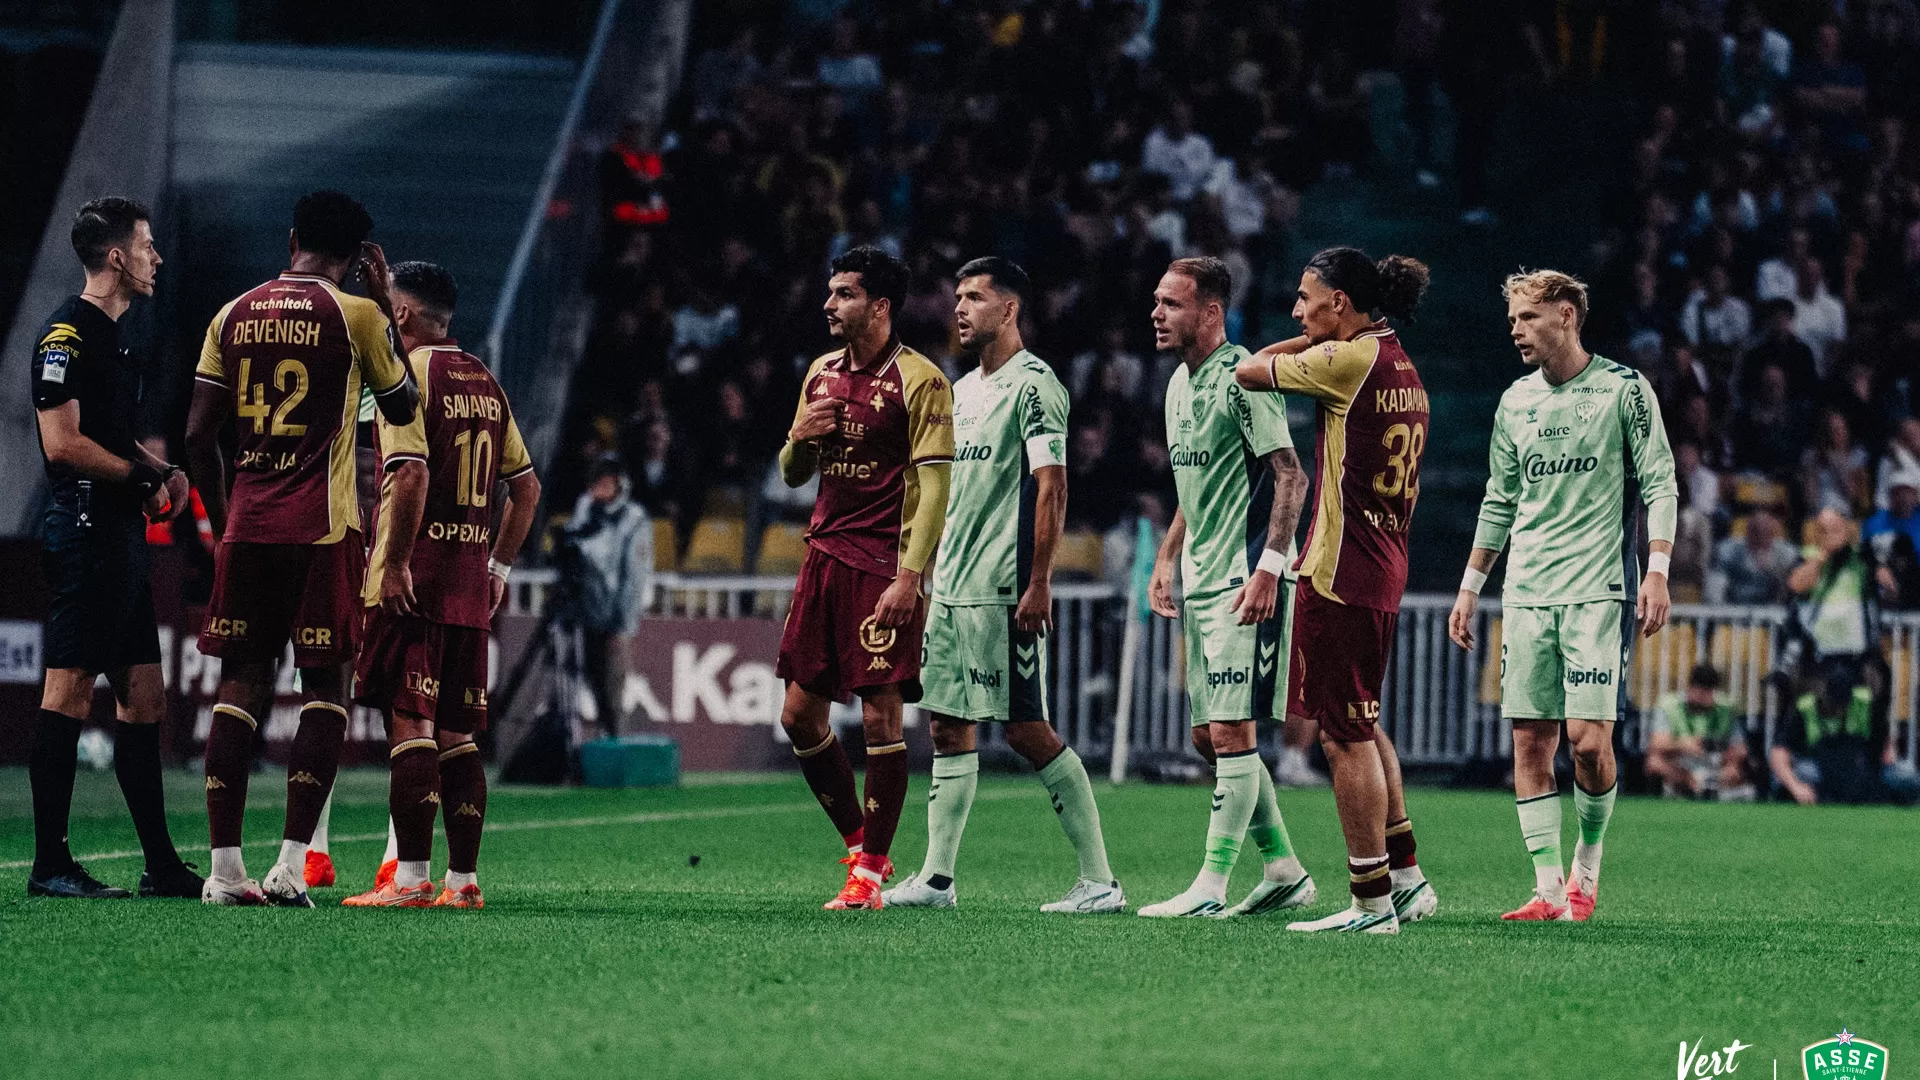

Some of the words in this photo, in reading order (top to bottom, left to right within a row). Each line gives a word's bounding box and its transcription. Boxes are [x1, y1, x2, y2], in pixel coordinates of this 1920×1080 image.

[233, 319, 321, 346] DEVENISH
[50, 343, 80, 358] POSTE
[237, 357, 309, 437] 42
[454, 429, 493, 508] 10
[1372, 422, 1424, 499] 38
[1525, 453, 1598, 484] Casino
[210, 616, 248, 638] LCR
[295, 627, 331, 645] LCR
